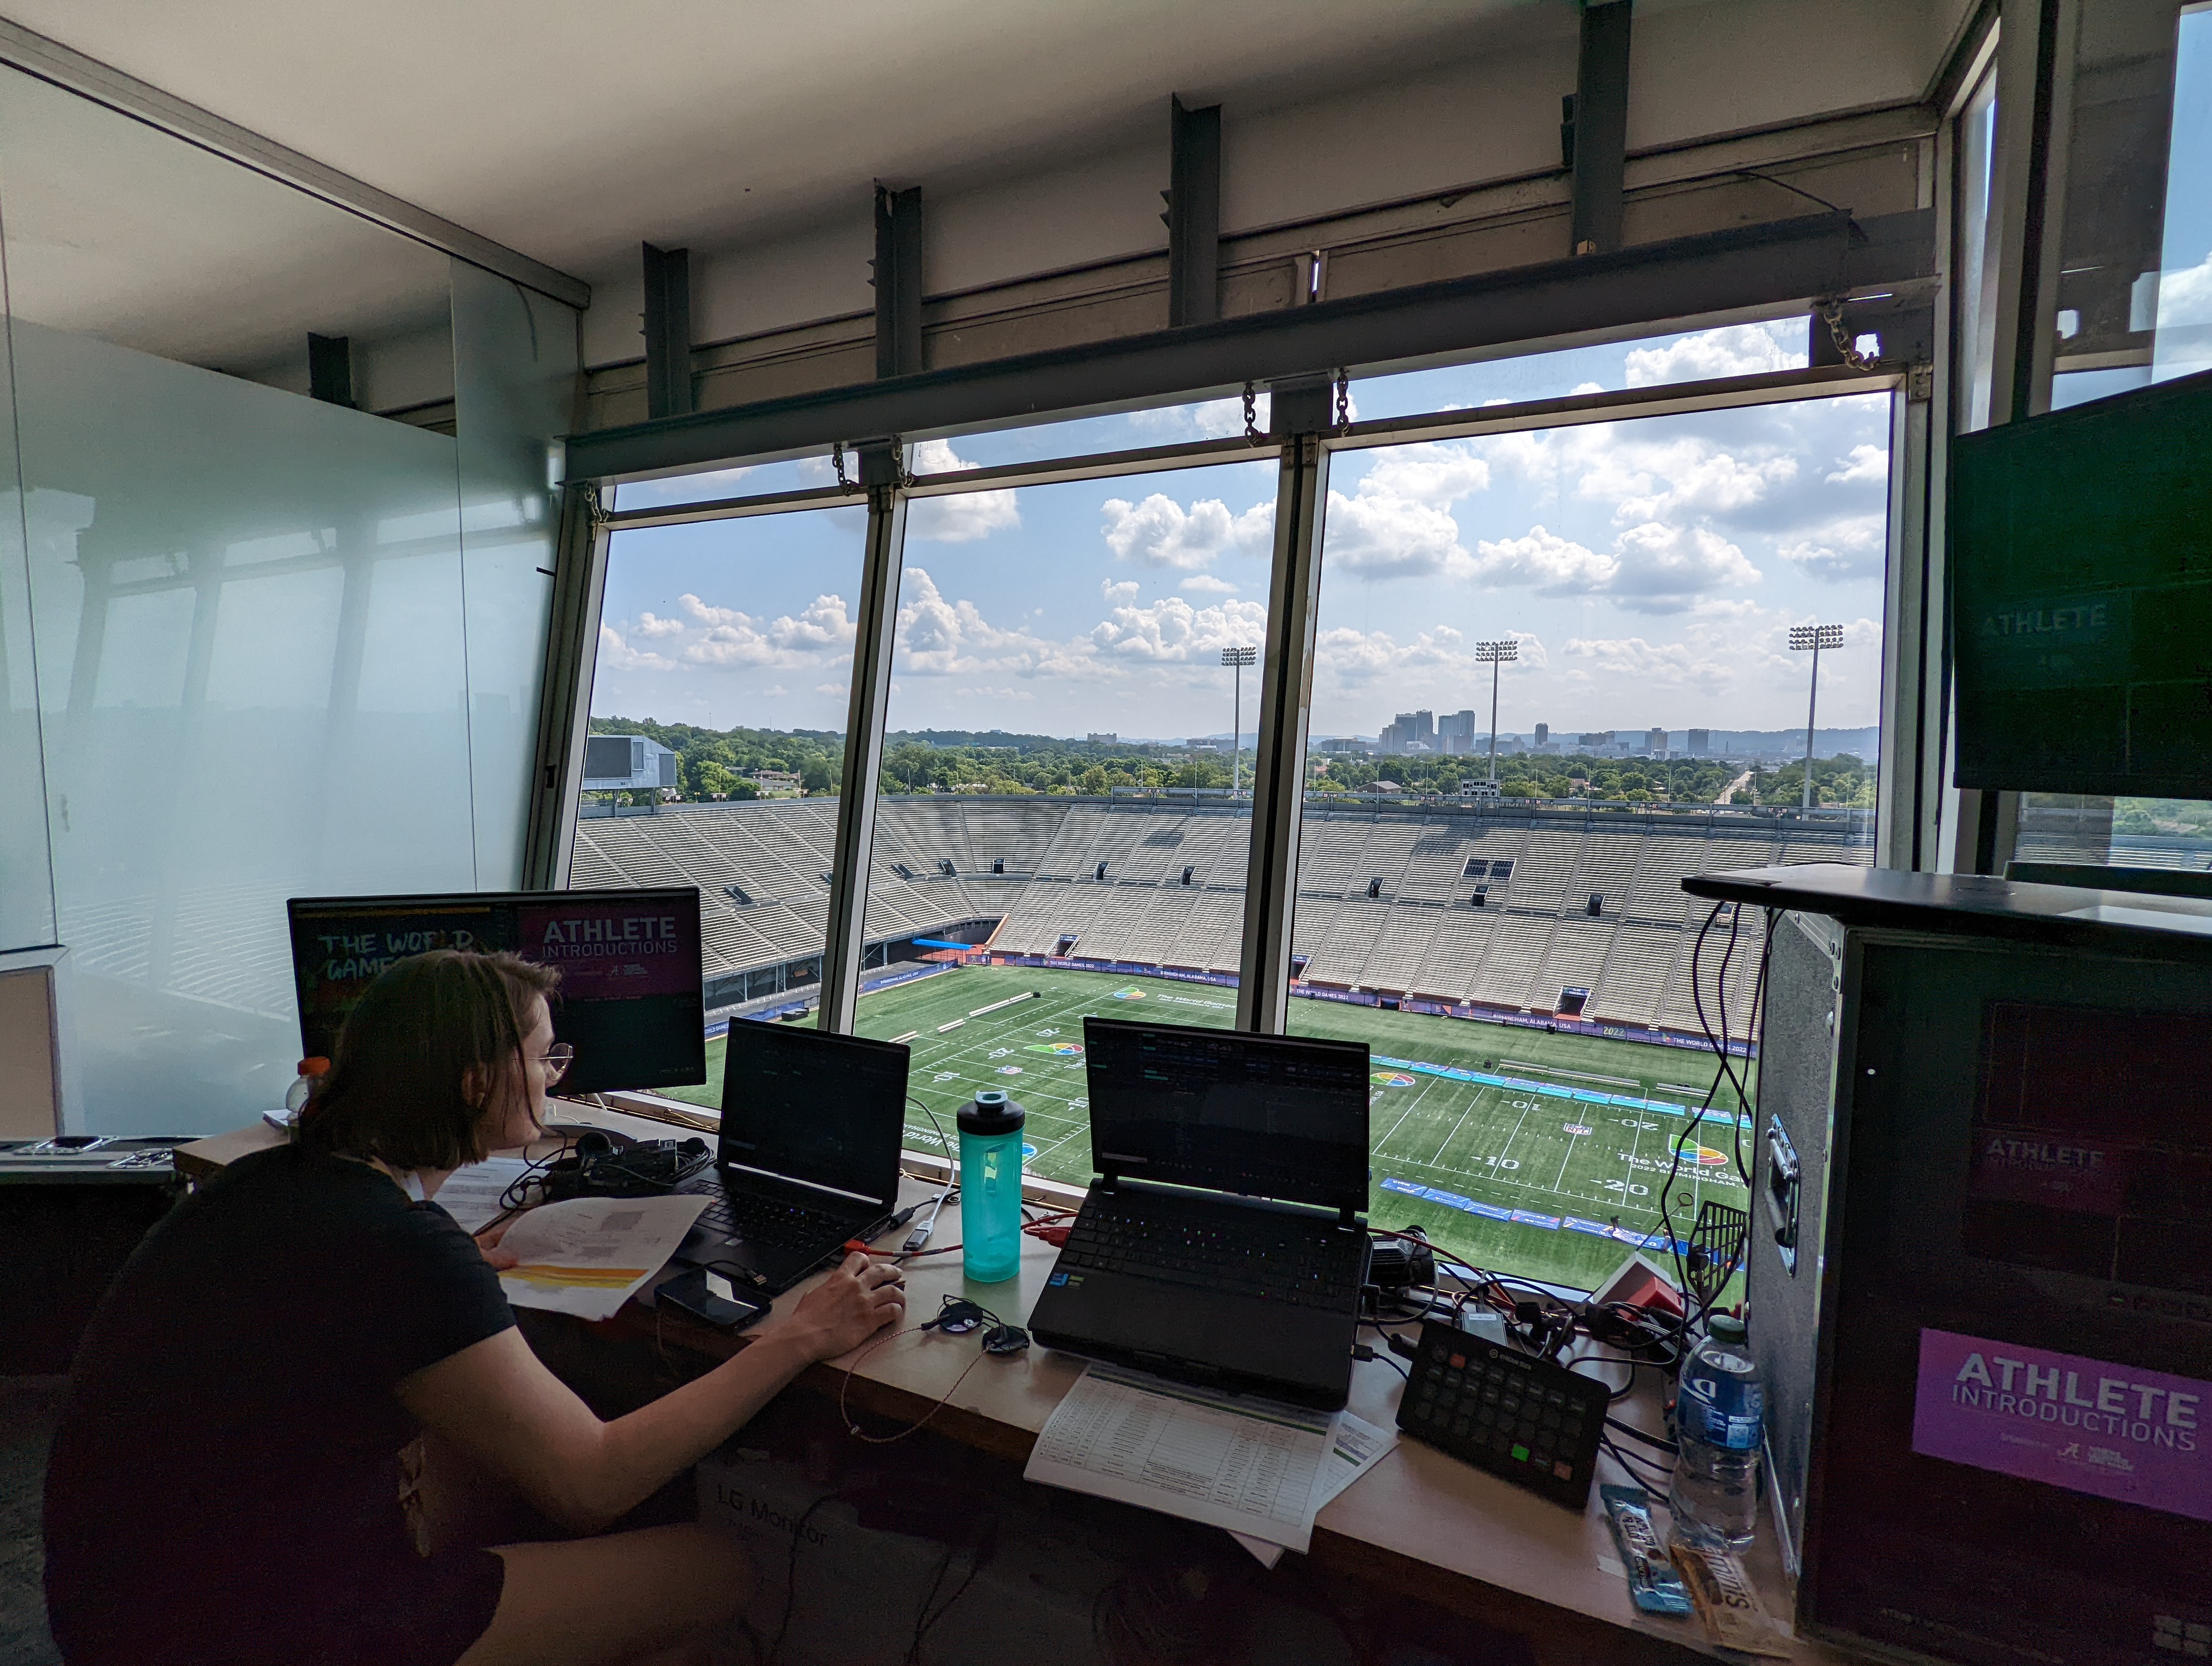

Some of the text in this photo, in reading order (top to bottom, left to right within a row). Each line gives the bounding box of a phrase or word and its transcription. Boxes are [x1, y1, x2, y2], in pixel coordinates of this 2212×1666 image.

[543, 917, 677, 944] ATHLETE
[318, 933, 377, 953] THE
[542, 940, 678, 957] INTRODUCTIONS
[1603, 1026, 1625, 1037] 2022
[1686, 1039, 1708, 1047] WORLD
[1486, 1156, 1520, 1169] 10
[1617, 1152, 1650, 1165] The
[1655, 1159, 1709, 1176] World
[1631, 1164, 1656, 1172] 2022
[1604, 1179, 1649, 1195] 20
[1956, 1353, 2200, 1430] ATHLETE
[1952, 1384, 2196, 1452] INTRODUCTIONS
[717, 1483, 744, 1511] LG
